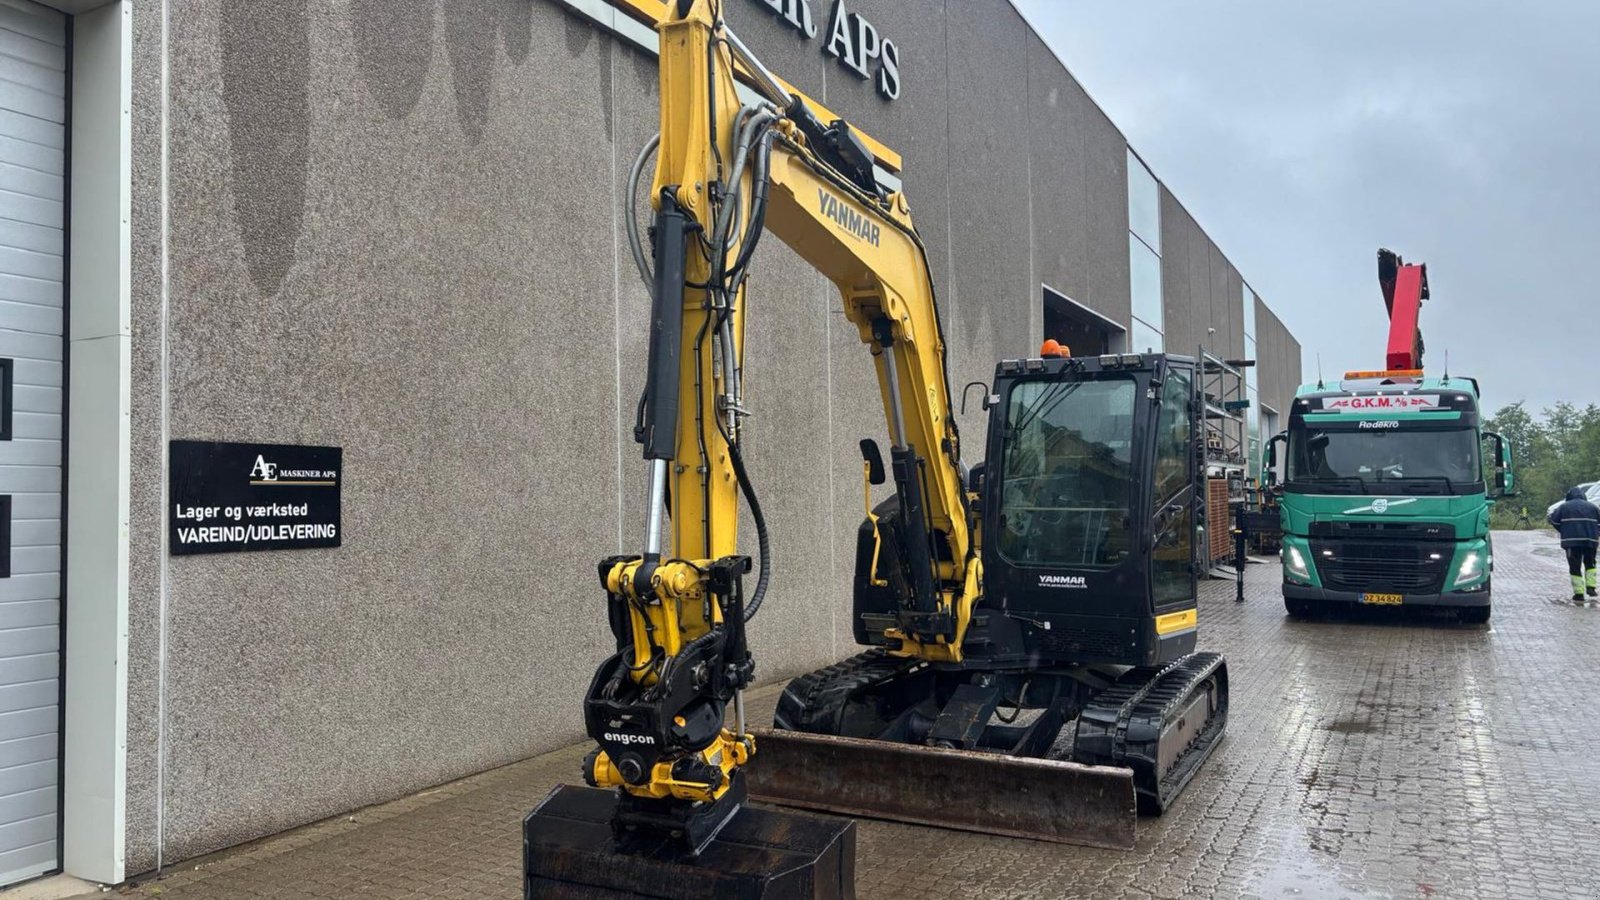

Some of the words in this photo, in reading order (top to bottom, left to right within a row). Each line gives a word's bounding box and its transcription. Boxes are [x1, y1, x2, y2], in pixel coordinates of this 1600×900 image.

[826, 0, 901, 101] APS
[817, 187, 880, 248] YANMAR
[1350, 397, 1393, 408] G.K.M.
[280, 469, 321, 478] MASKINER
[322, 470, 337, 478] APS
[176, 503, 220, 522] Lager
[224, 506, 242, 520] og
[246, 502, 308, 517] værksted
[177, 523, 336, 544] VAREIND/UDLEVERING
[1039, 575, 1086, 584] YANMAR
[603, 732, 655, 745] engcon
